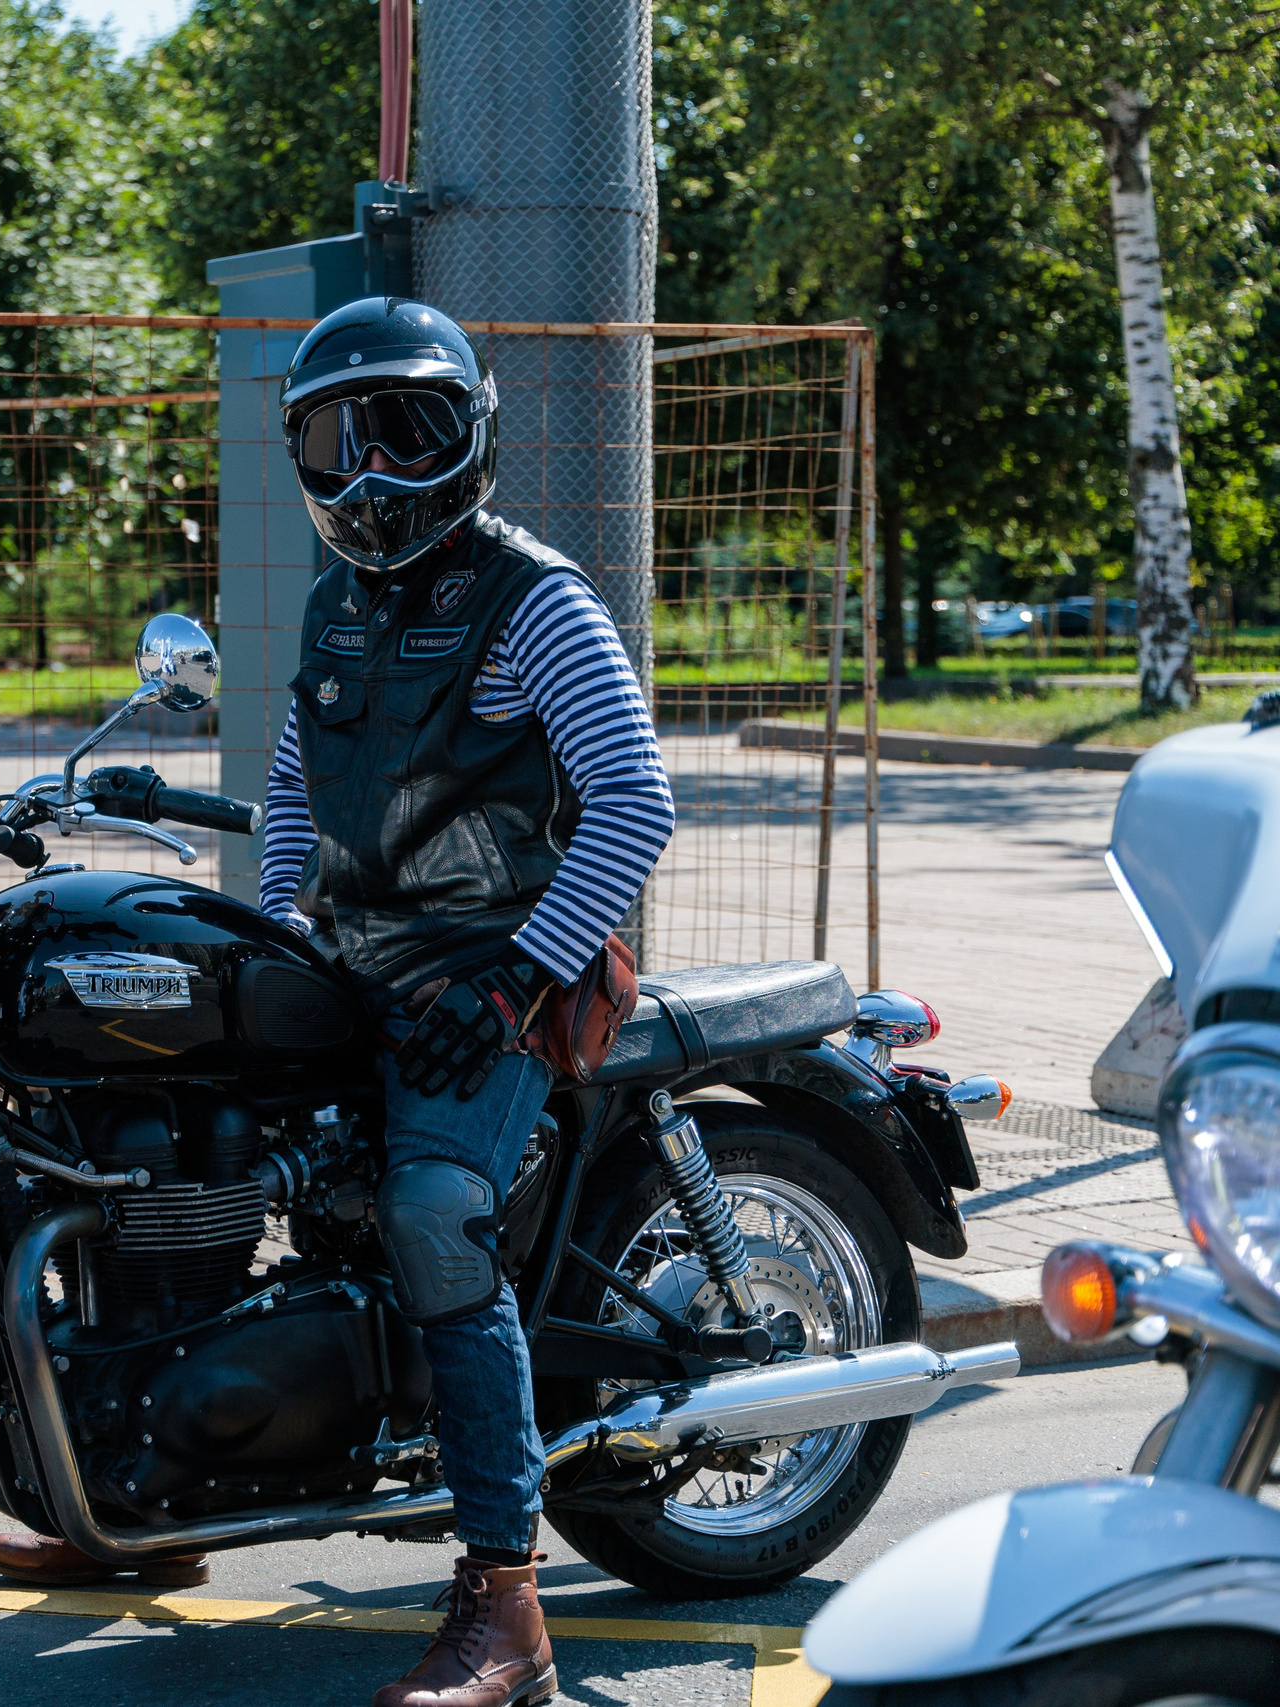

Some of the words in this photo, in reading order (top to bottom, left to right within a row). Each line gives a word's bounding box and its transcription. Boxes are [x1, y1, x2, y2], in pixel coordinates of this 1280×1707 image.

[87, 975, 181, 999] TRIUMPH
[805, 1476, 867, 1541] 130/80
[756, 1545, 780, 1563] 17
[785, 1537, 799, 1553] B
